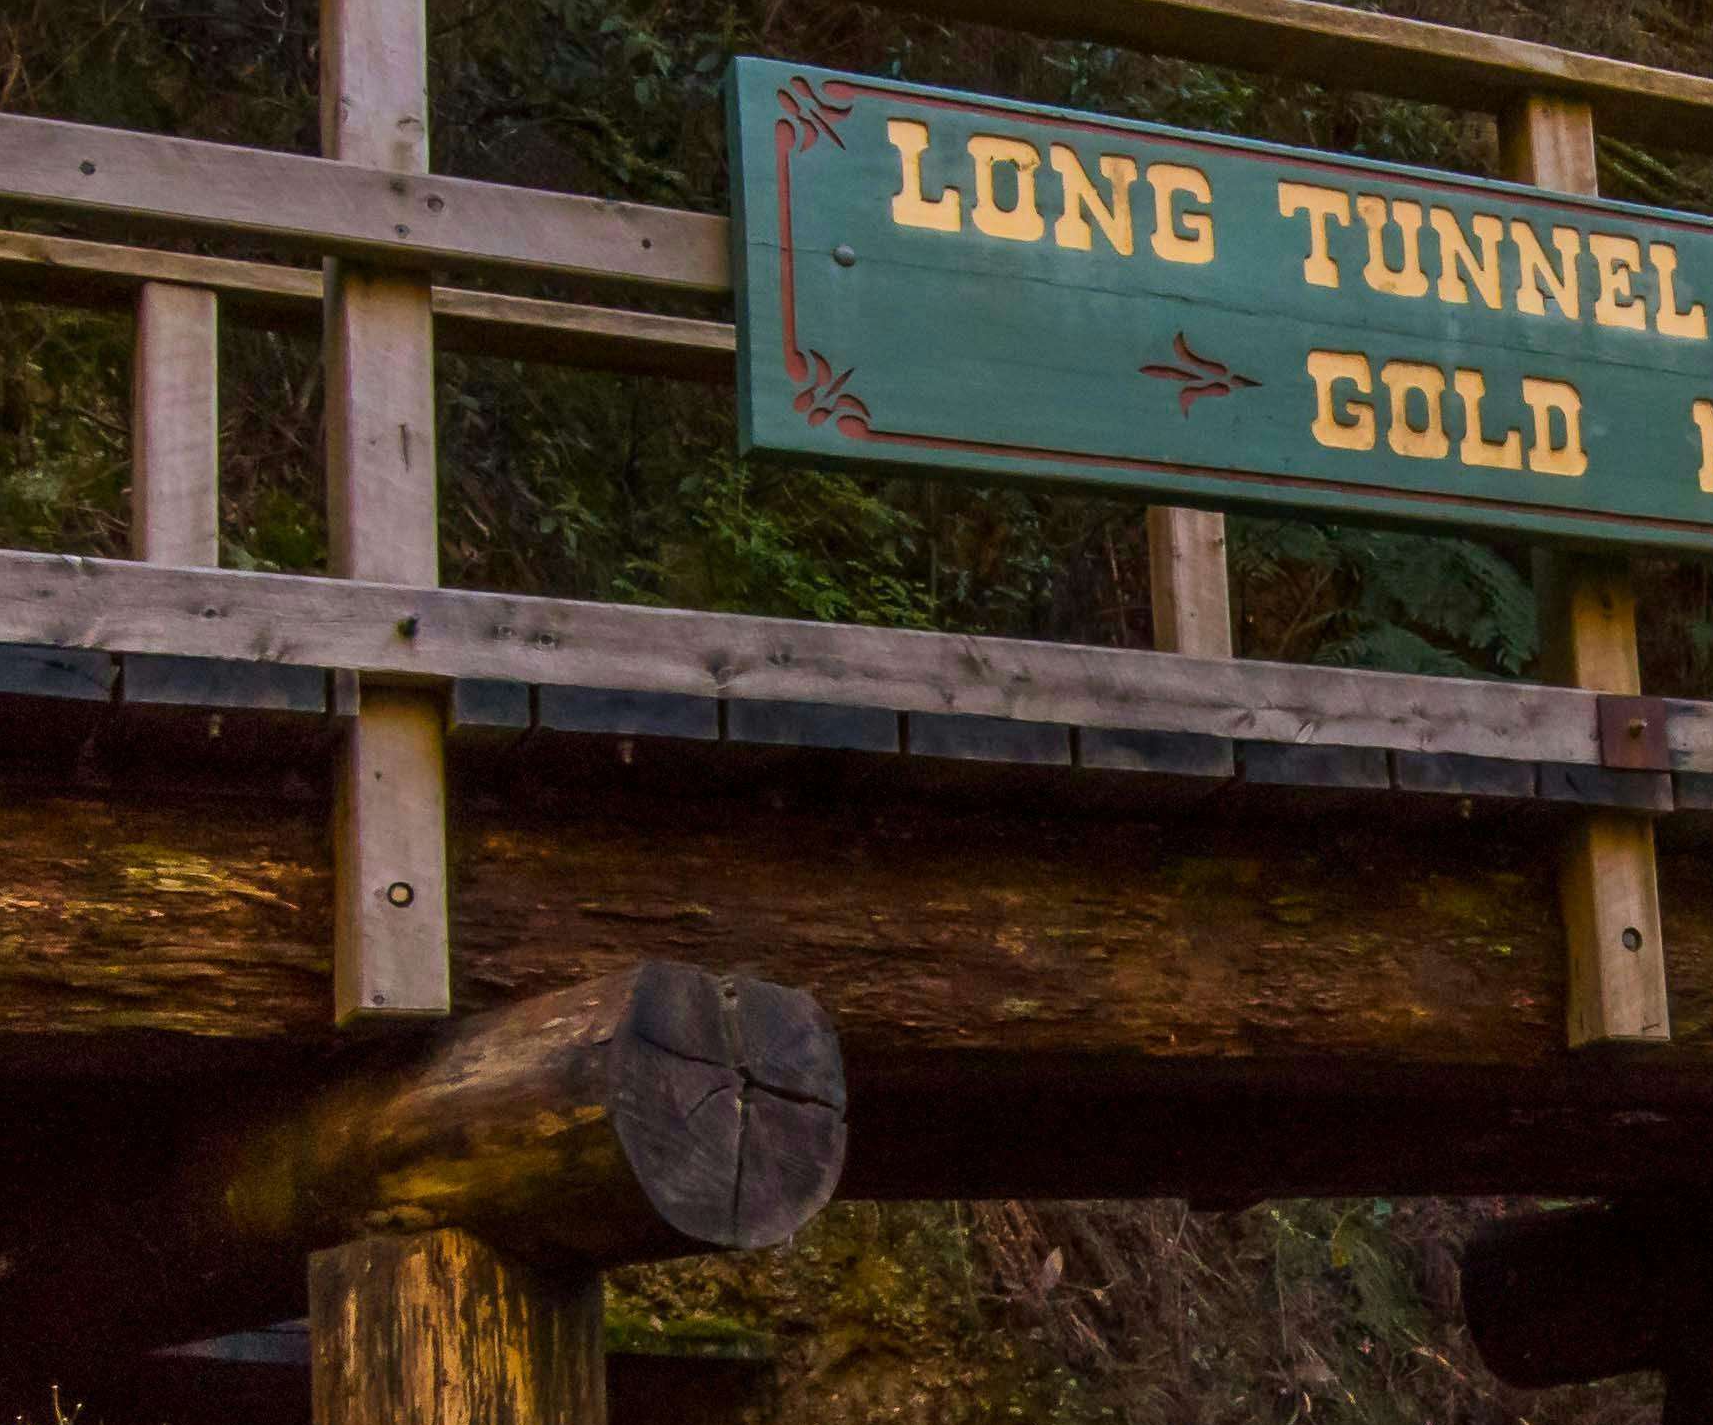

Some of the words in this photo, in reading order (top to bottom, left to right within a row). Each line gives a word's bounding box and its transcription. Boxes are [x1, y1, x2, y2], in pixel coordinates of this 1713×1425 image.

[885, 117, 1217, 266] LONG
[1277, 181, 1709, 340] TUNNEL
[1306, 349, 1589, 480] GOLD
